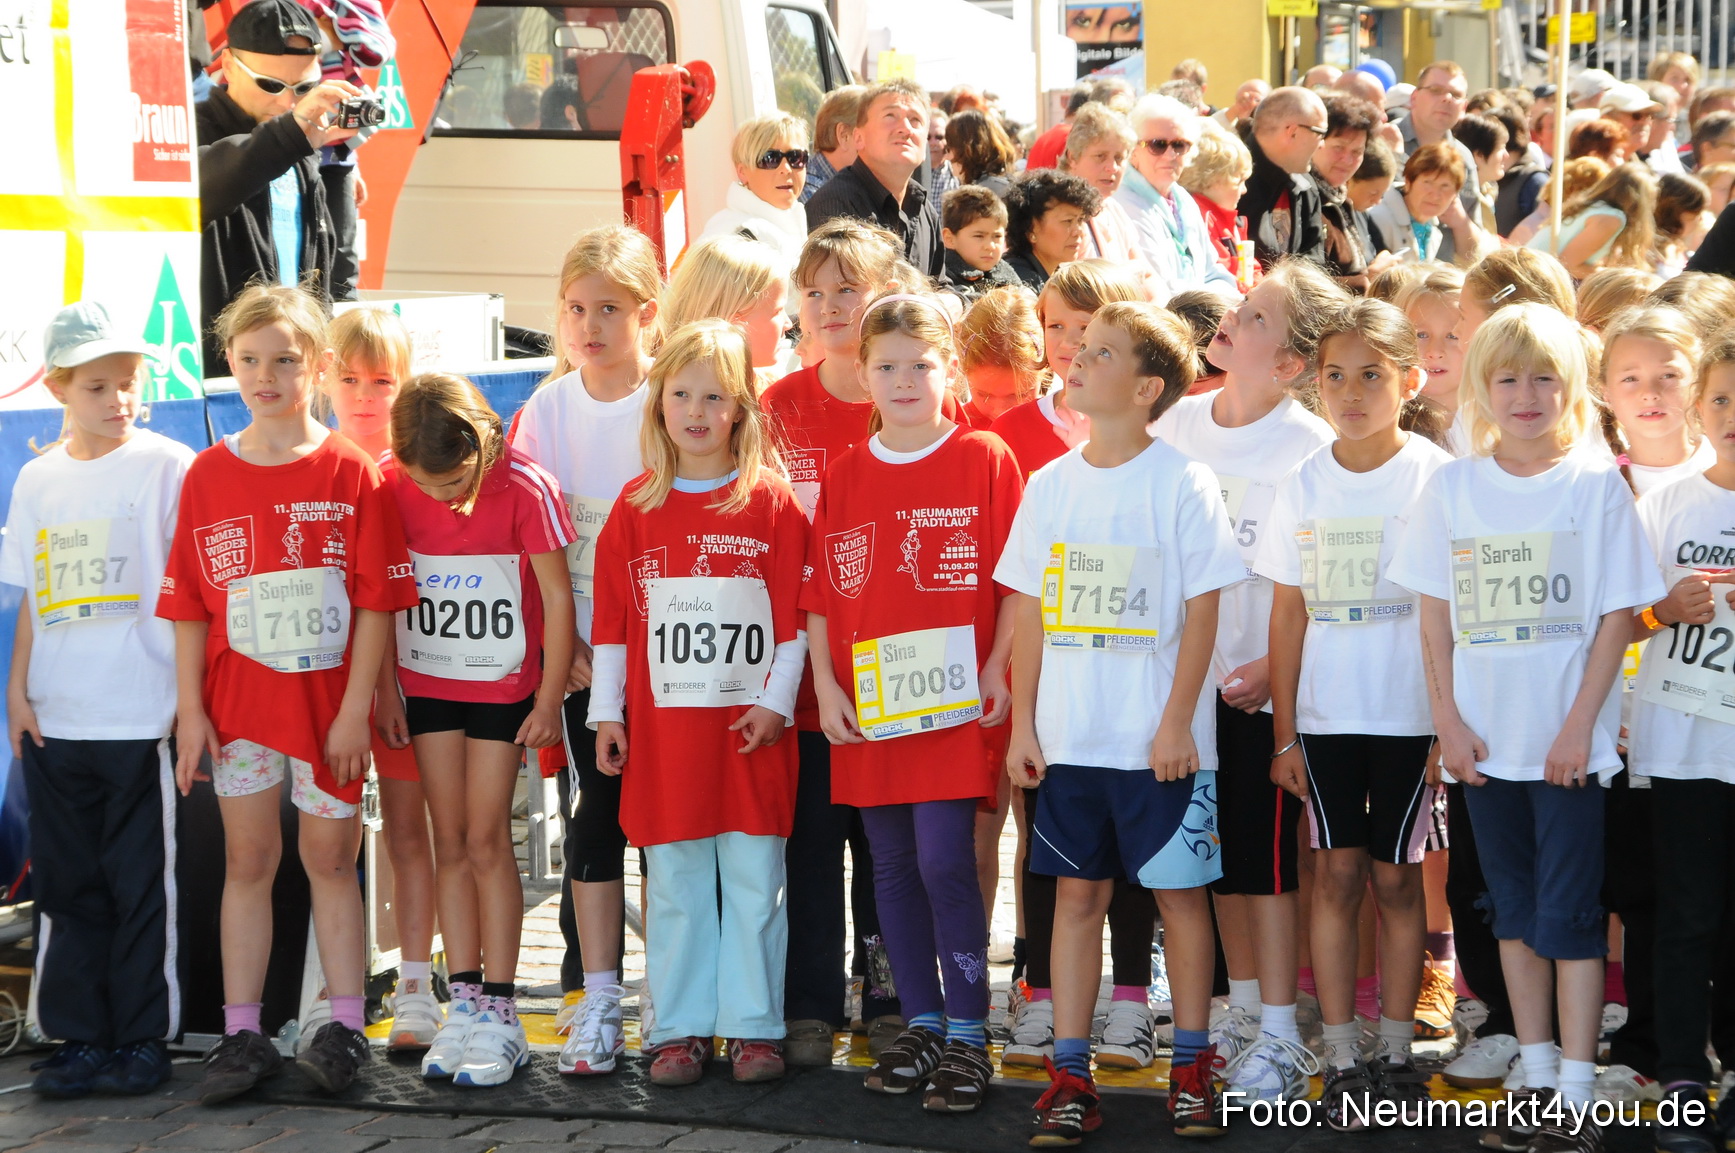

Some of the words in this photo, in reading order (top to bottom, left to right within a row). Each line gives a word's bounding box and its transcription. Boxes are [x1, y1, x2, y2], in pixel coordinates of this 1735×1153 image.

[131, 91, 189, 144] Braun
[274, 504, 290, 514] 11.
[896, 510, 911, 521] 11.
[912, 506, 978, 519] NEUMARKTE
[909, 517, 972, 529] STADTLAUF
[50, 528, 88, 553] Paula
[204, 527, 246, 547] IMMER
[686, 534, 701, 545] 11.
[833, 534, 867, 553] IMMER
[1320, 526, 1385, 547] Vanessa
[204, 538, 248, 558] WIEDER
[699, 544, 759, 559] STADTLAUF
[833, 545, 868, 564] WIEDER
[1481, 541, 1533, 565] Sarah
[209, 549, 246, 573] NEU
[837, 557, 867, 580] NEU
[938, 562, 978, 571] 19.09.201
[1069, 550, 1104, 573] Elisa
[53, 555, 128, 590] 7137
[212, 565, 247, 584] MARKT
[259, 578, 315, 603] Sophie
[1045, 582, 1057, 597] K3
[1458, 578, 1472, 595] K3
[1485, 573, 1572, 608] 7190
[92, 601, 140, 612] PFLEIDERER
[666, 594, 715, 614] Annika
[1069, 584, 1149, 617] 7154
[1363, 603, 1413, 616] PFLEIDERER
[232, 613, 249, 630] K3
[263, 606, 342, 640] 7183
[406, 596, 515, 641] 10206
[1469, 630, 1498, 641] BOCK
[1531, 623, 1583, 635] PFLEIDERER
[654, 621, 765, 666] 10370
[1106, 634, 1156, 646] PFLEIDERER
[419, 651, 453, 663] PFLEIDERER
[883, 643, 917, 664] Sina
[671, 682, 706, 690] PFLEIDERER
[859, 677, 874, 694] K3
[888, 663, 967, 702] 7008
[1671, 681, 1708, 697] PFLEIDERER
[933, 705, 981, 722] PFLEIDERER
[872, 722, 904, 735] BOCK
